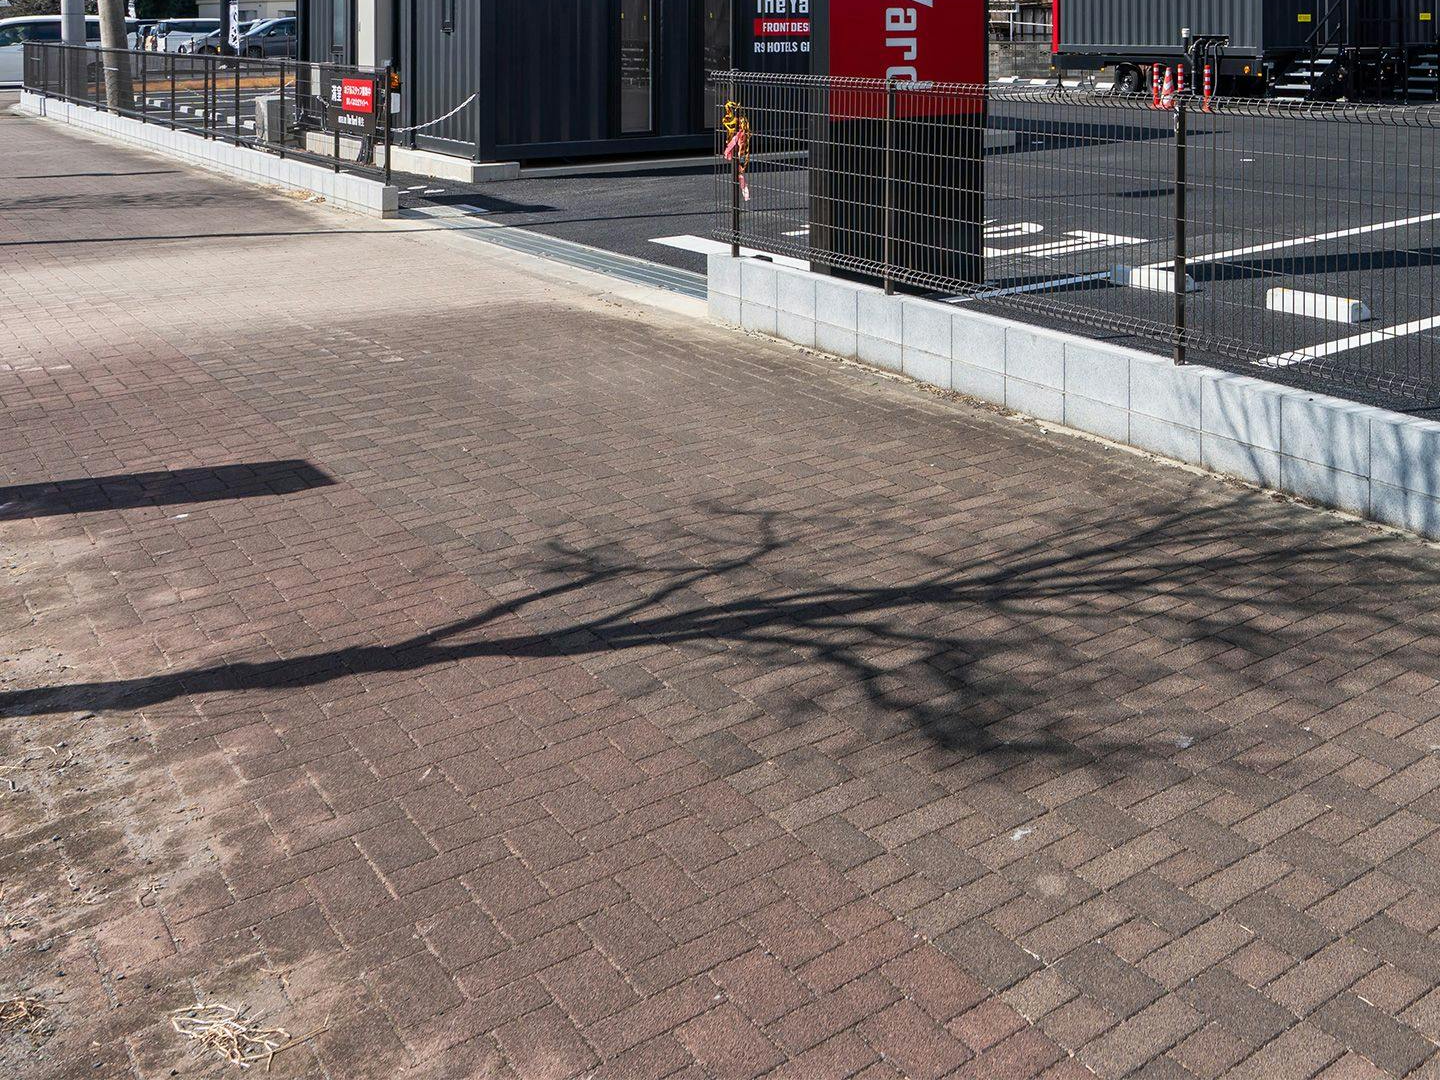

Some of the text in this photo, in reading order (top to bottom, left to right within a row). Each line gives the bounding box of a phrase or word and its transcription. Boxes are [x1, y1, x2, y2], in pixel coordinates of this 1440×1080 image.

[762, 22, 811, 32] FRONT DES
[754, 42, 766, 53] R9
[767, 41, 798, 53] HOTELS
